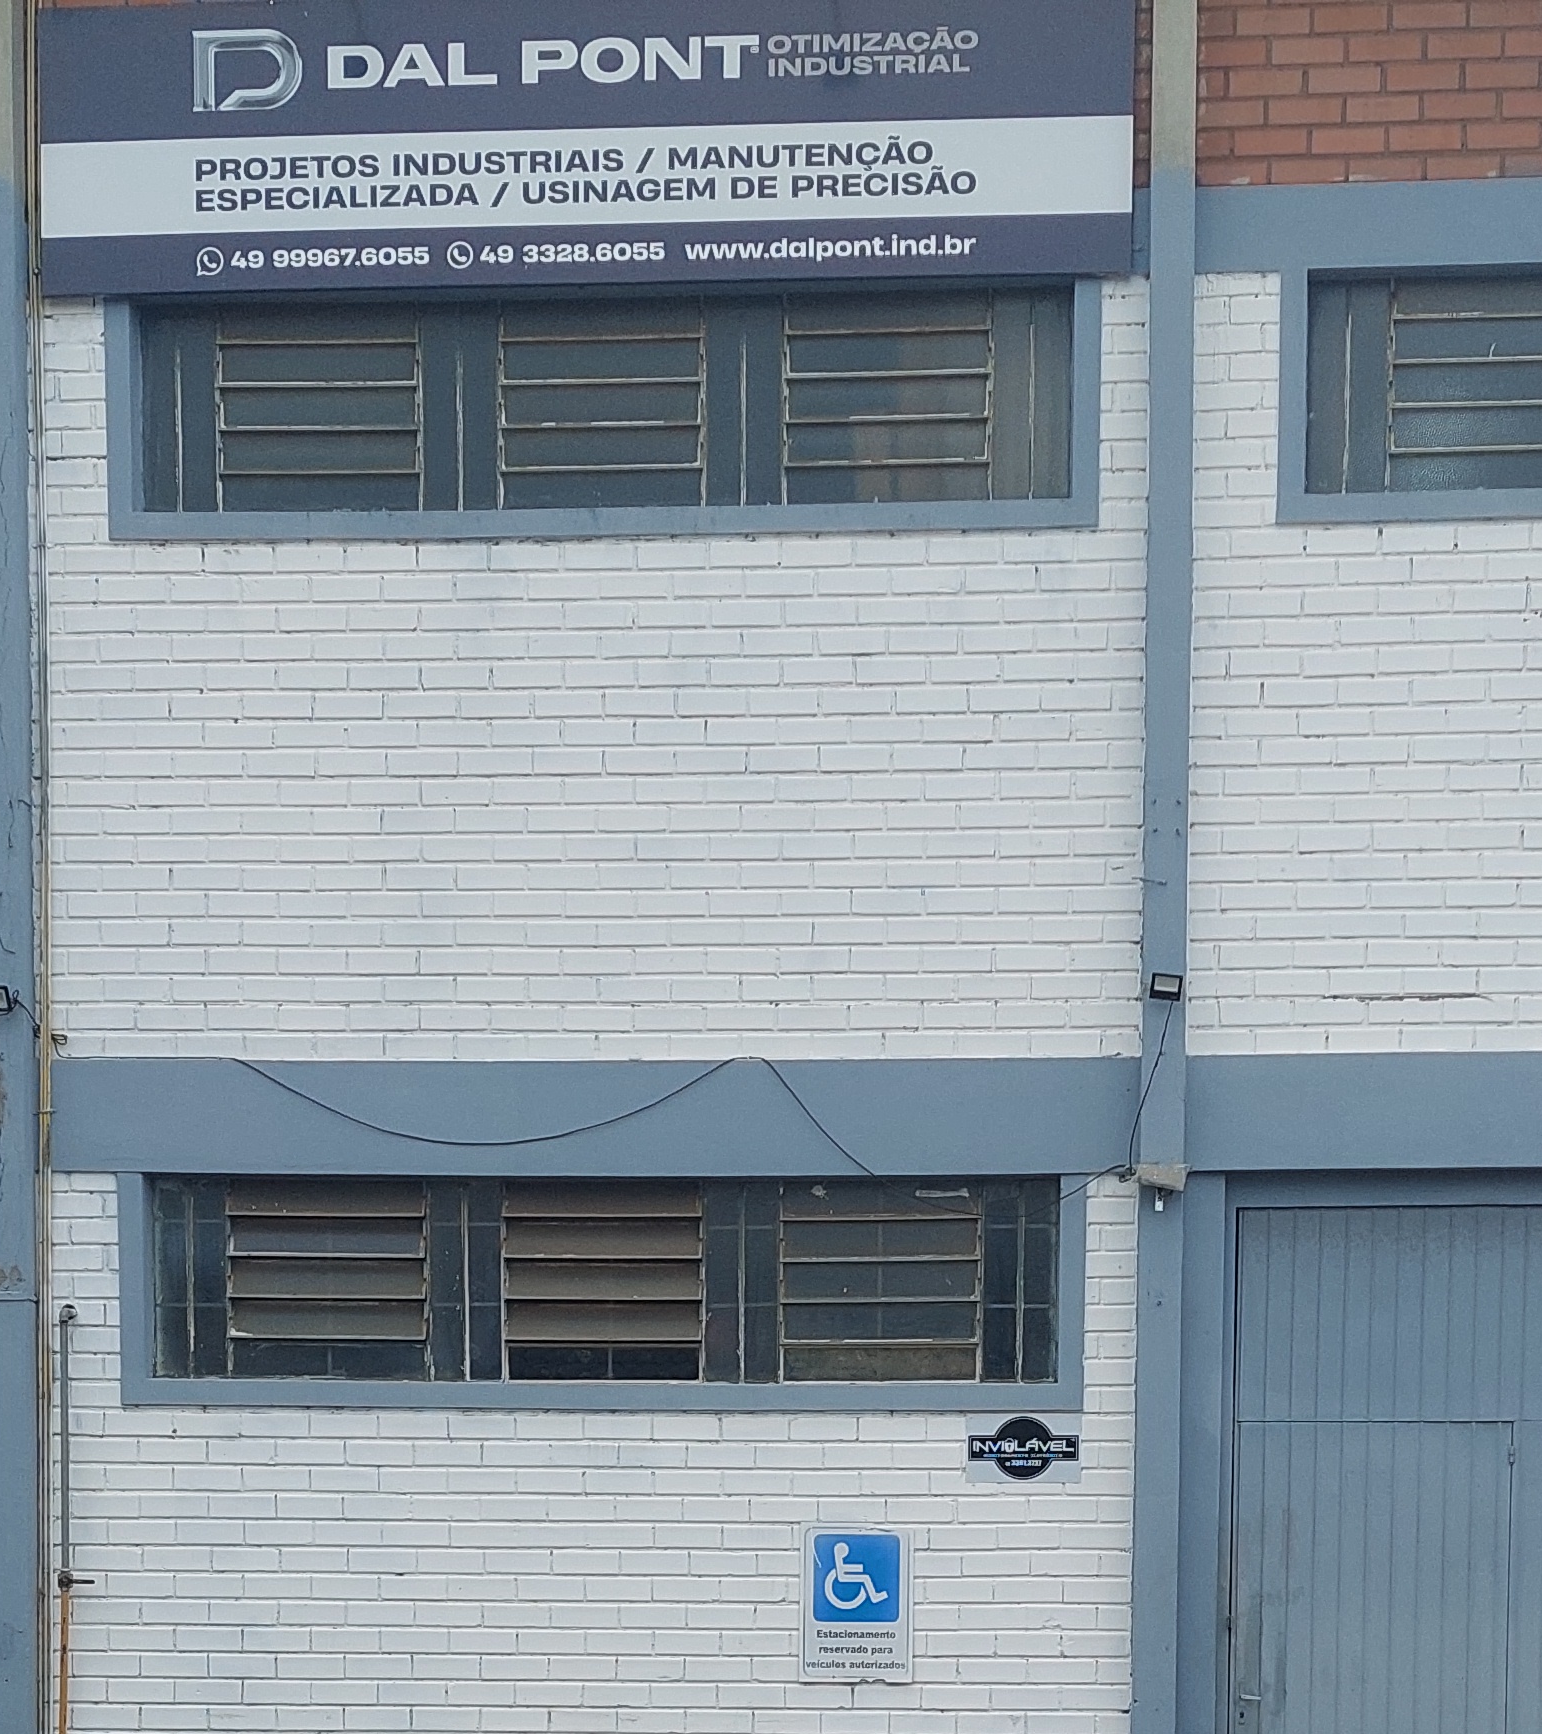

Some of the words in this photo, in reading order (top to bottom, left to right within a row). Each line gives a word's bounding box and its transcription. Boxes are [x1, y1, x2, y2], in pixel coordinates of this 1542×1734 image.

[767, 26, 979, 56] OTIMIZAÇÃO
[327, 42, 498, 89] DAL
[521, 34, 760, 84] PONT
[767, 52, 971, 77] INDUSTRIAL
[195, 154, 380, 182] PROJETOS
[392, 147, 624, 177] INDUSTRIAIS
[635, 147, 655, 173] /
[668, 135, 934, 171] MANUTENÇÃO
[195, 182, 479, 212] ESPECIALIZADA
[489, 181, 509, 208] /
[522, 177, 716, 205] USINAGEM
[730, 175, 778, 200] DE
[791, 165, 977, 199] PRECISÃO
[230, 249, 265, 269] 49
[272, 246, 430, 268] 99967.6055
[479, 244, 514, 264] 49
[522, 242, 666, 264] 3328.6055
[684, 233, 977, 263] www.dalpont.ind.br
[816, 1629, 896, 1640] Estacionamento
[818, 1645, 869, 1655] reservado
[870, 1647, 894, 1656] para
[806, 1660, 847, 1670] veículos
[848, 1660, 906, 1670] autorizados
